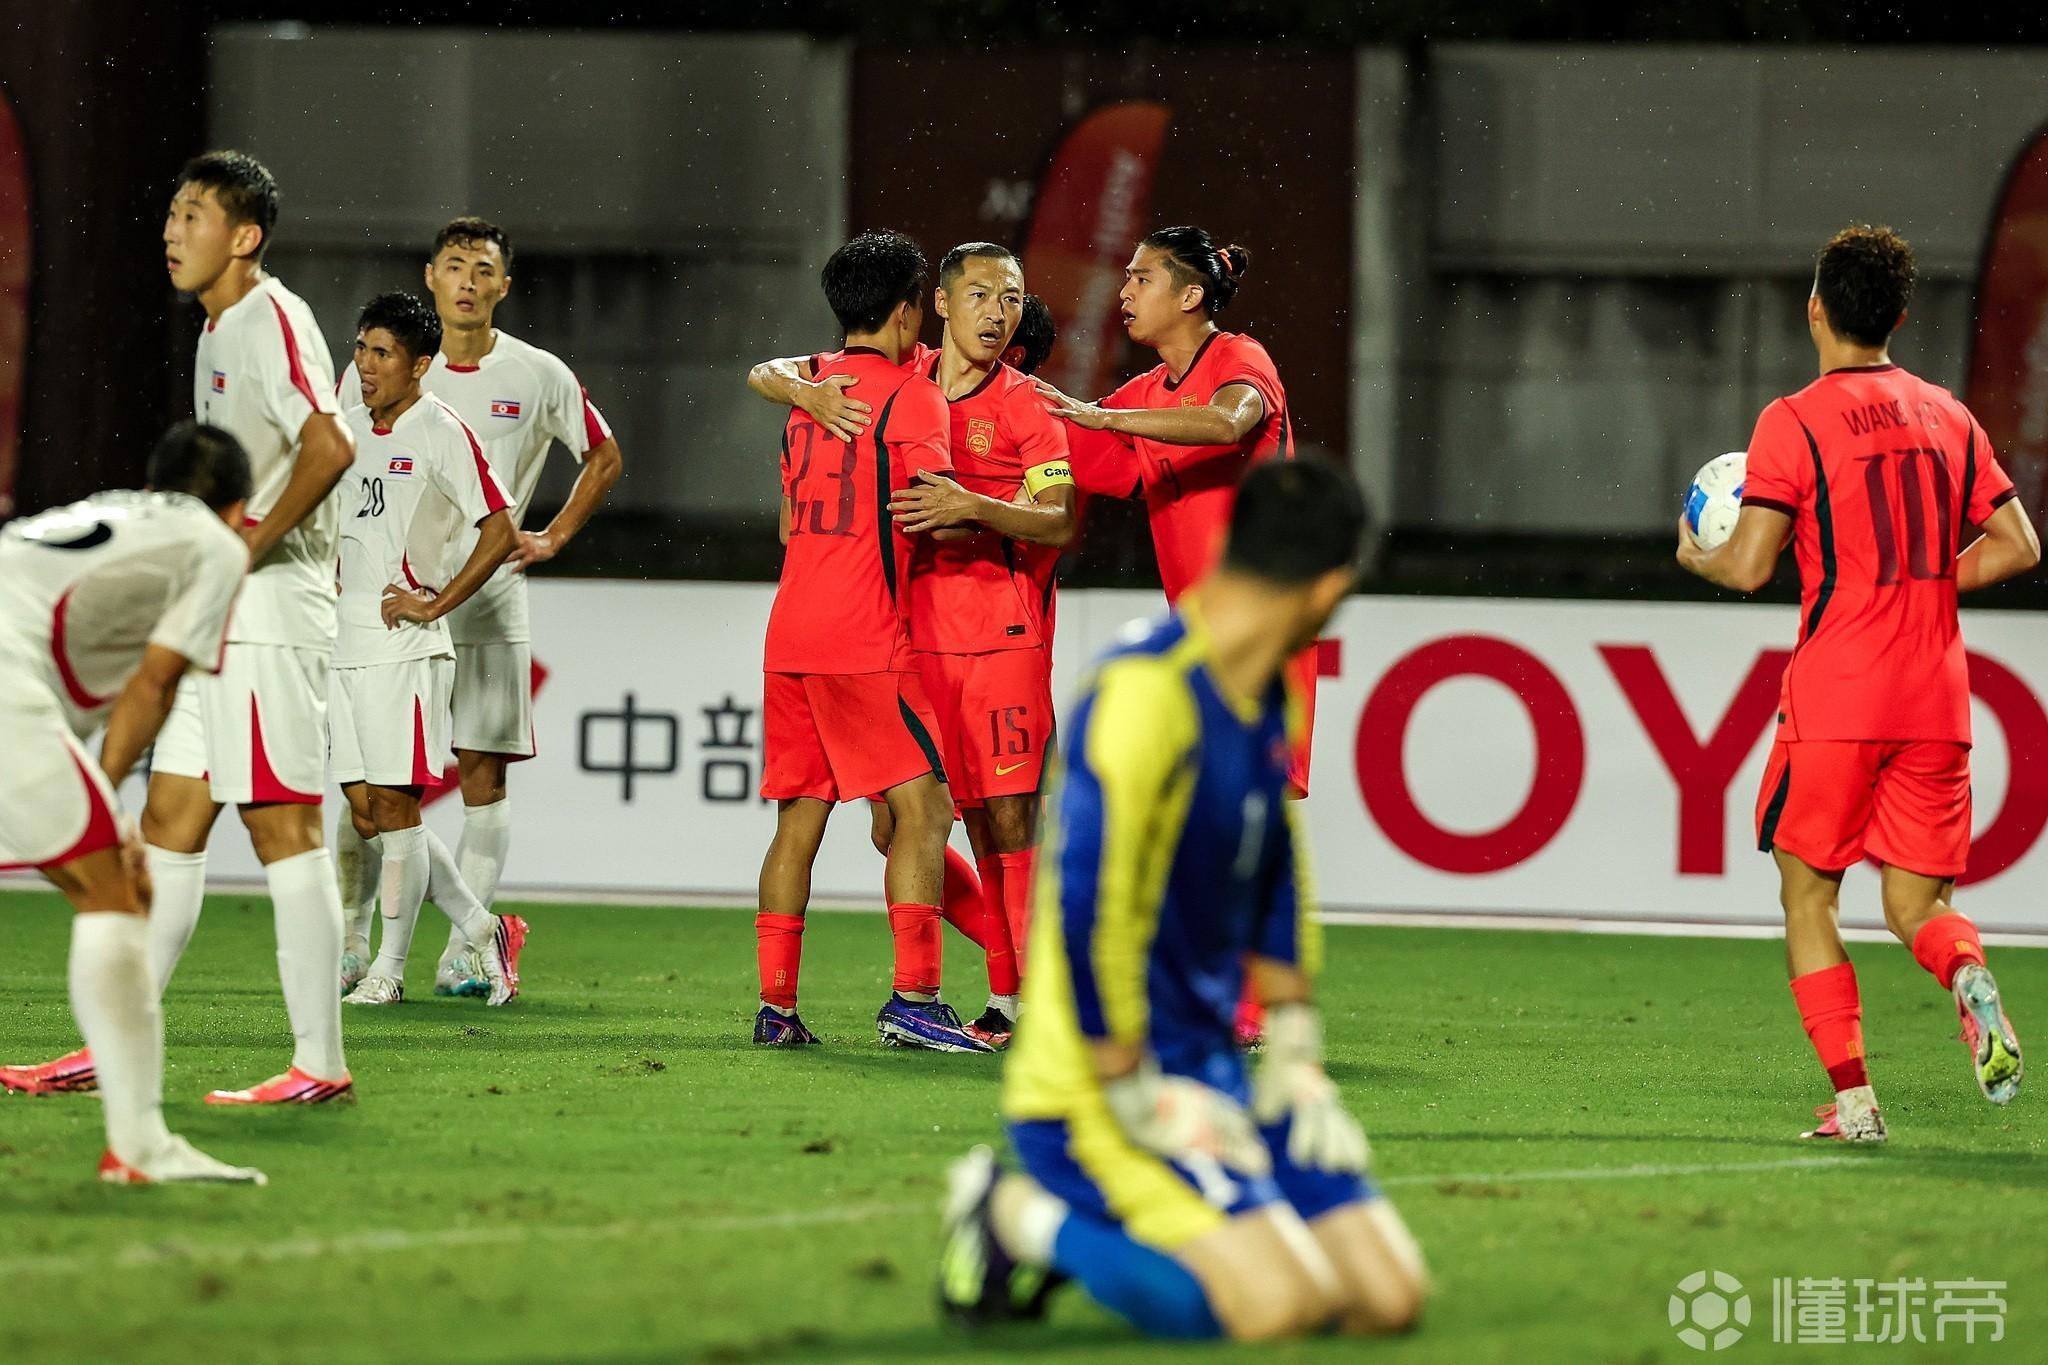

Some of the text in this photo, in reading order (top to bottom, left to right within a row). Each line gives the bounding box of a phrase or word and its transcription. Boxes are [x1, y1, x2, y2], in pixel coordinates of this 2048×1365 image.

[970, 420, 993, 432] CFA
[356, 476, 385, 518] 20
[789, 422, 858, 537] 23
[1853, 447, 1952, 587] 10
[987, 705, 1032, 758] 15
